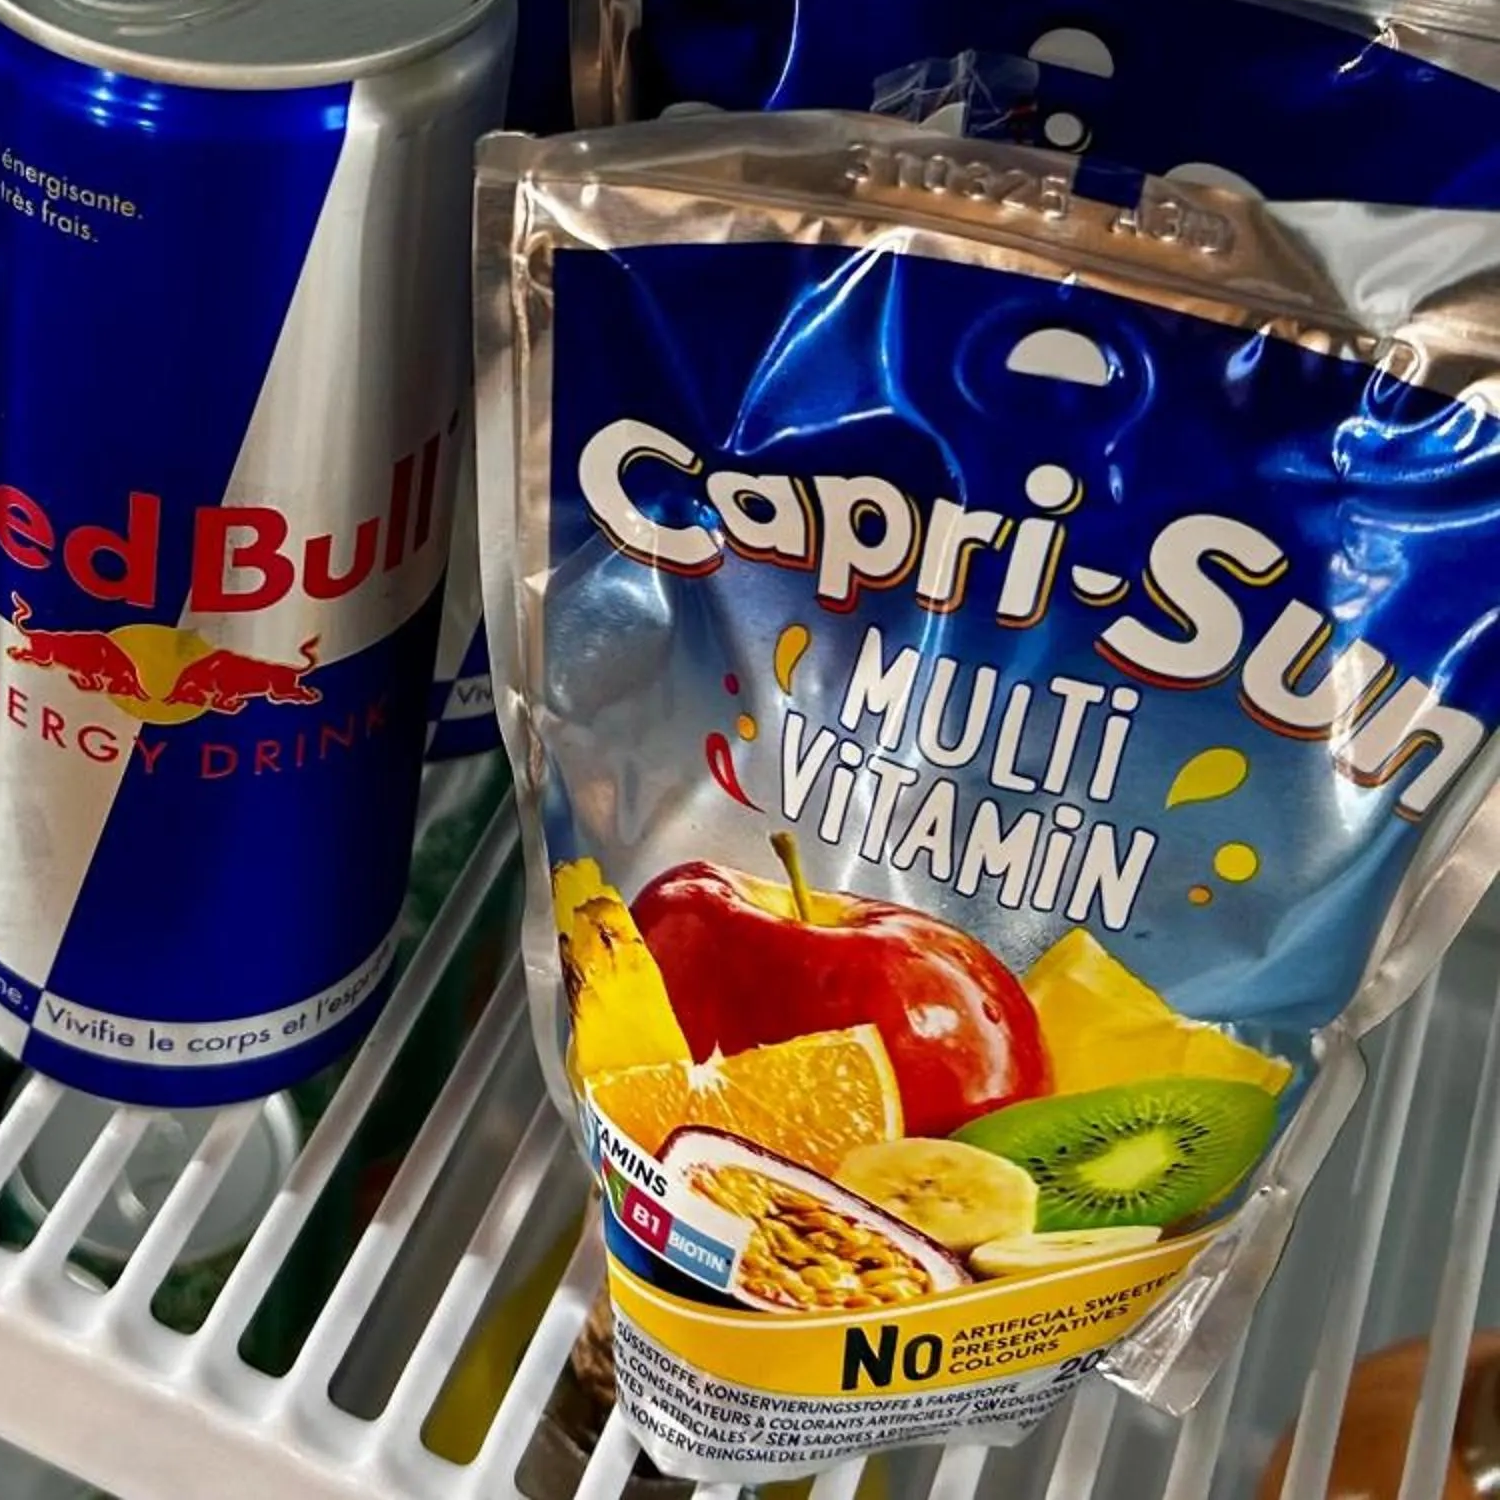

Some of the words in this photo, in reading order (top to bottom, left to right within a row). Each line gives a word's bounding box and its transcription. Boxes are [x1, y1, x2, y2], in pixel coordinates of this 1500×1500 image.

[2, 148, 144, 219] énergisante.
[41, 199, 99, 243] frais.
[190, 434, 441, 613] Bull
[577, 418, 1490, 824] Capri-Sun
[201, 692, 389, 780] DRINK
[45, 999, 136, 1048] Vivifie
[149, 1027, 175, 1052] le
[187, 1028, 271, 1055] corps
[282, 1012, 307, 1036] et
[594, 1115, 669, 1197] AMINS
[631, 1202, 661, 1237] B1
[951, 1303, 1131, 1359] PRESERVATIVES
[953, 1304, 1078, 1344] ARTIFICIAL
[1084, 1271, 1179, 1312] SWEETE
[948, 1338, 1061, 1375] COLOURS
[629, 1356, 751, 1426] CONSERVATEURS
[755, 1417, 765, 1429] &
[769, 1417, 864, 1431] COLORANTS
[650, 1396, 747, 1444] ARTIFICIALES
